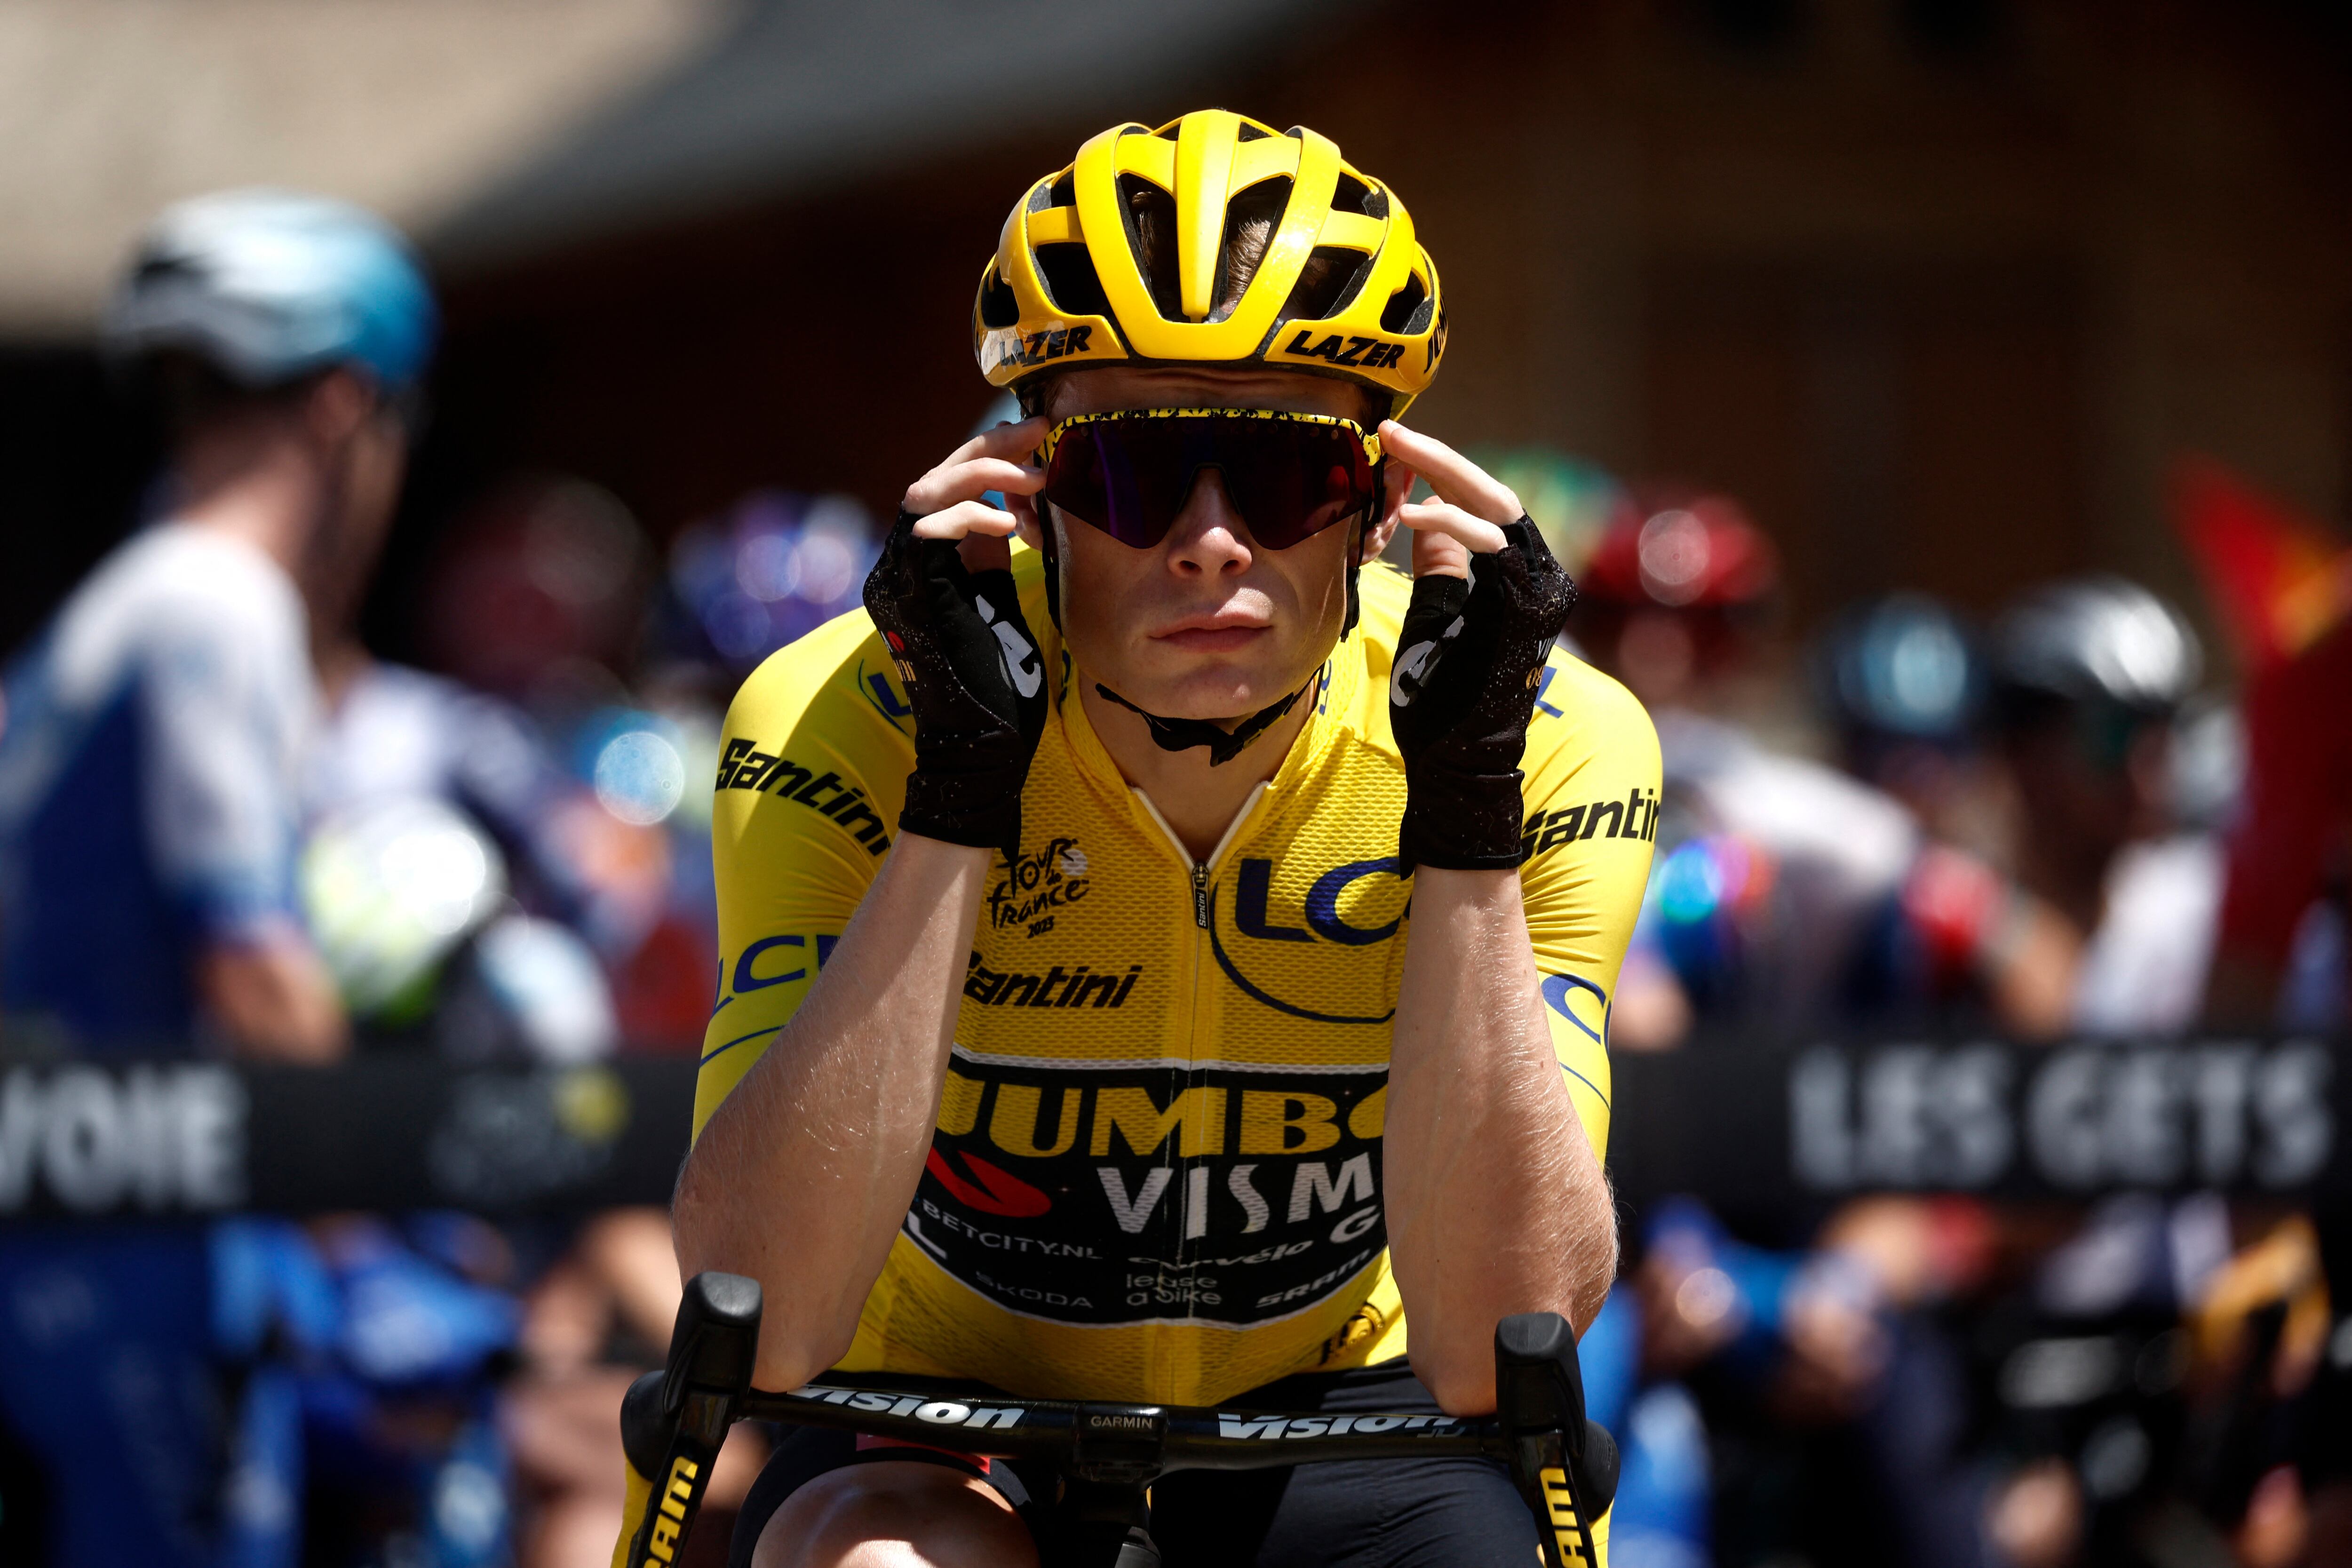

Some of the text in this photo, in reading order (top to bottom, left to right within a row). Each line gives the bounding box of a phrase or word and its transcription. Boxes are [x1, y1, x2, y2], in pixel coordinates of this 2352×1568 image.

[999, 326, 1092, 367] LAZER
[1285, 330, 1405, 369] LAZER
[1197, 892, 1206, 927] Santini
[1235, 857, 1411, 946] LC
[1027, 915, 1054, 939] 2023
[1795, 1047, 2333, 1186] LES GETS
[922, 1198, 1103, 1259] BETCITY.NL
[1127, 1273, 1217, 1289] lease
[1127, 1291, 1149, 1306] a
[1090, 1415, 1152, 1430] GARMIN
